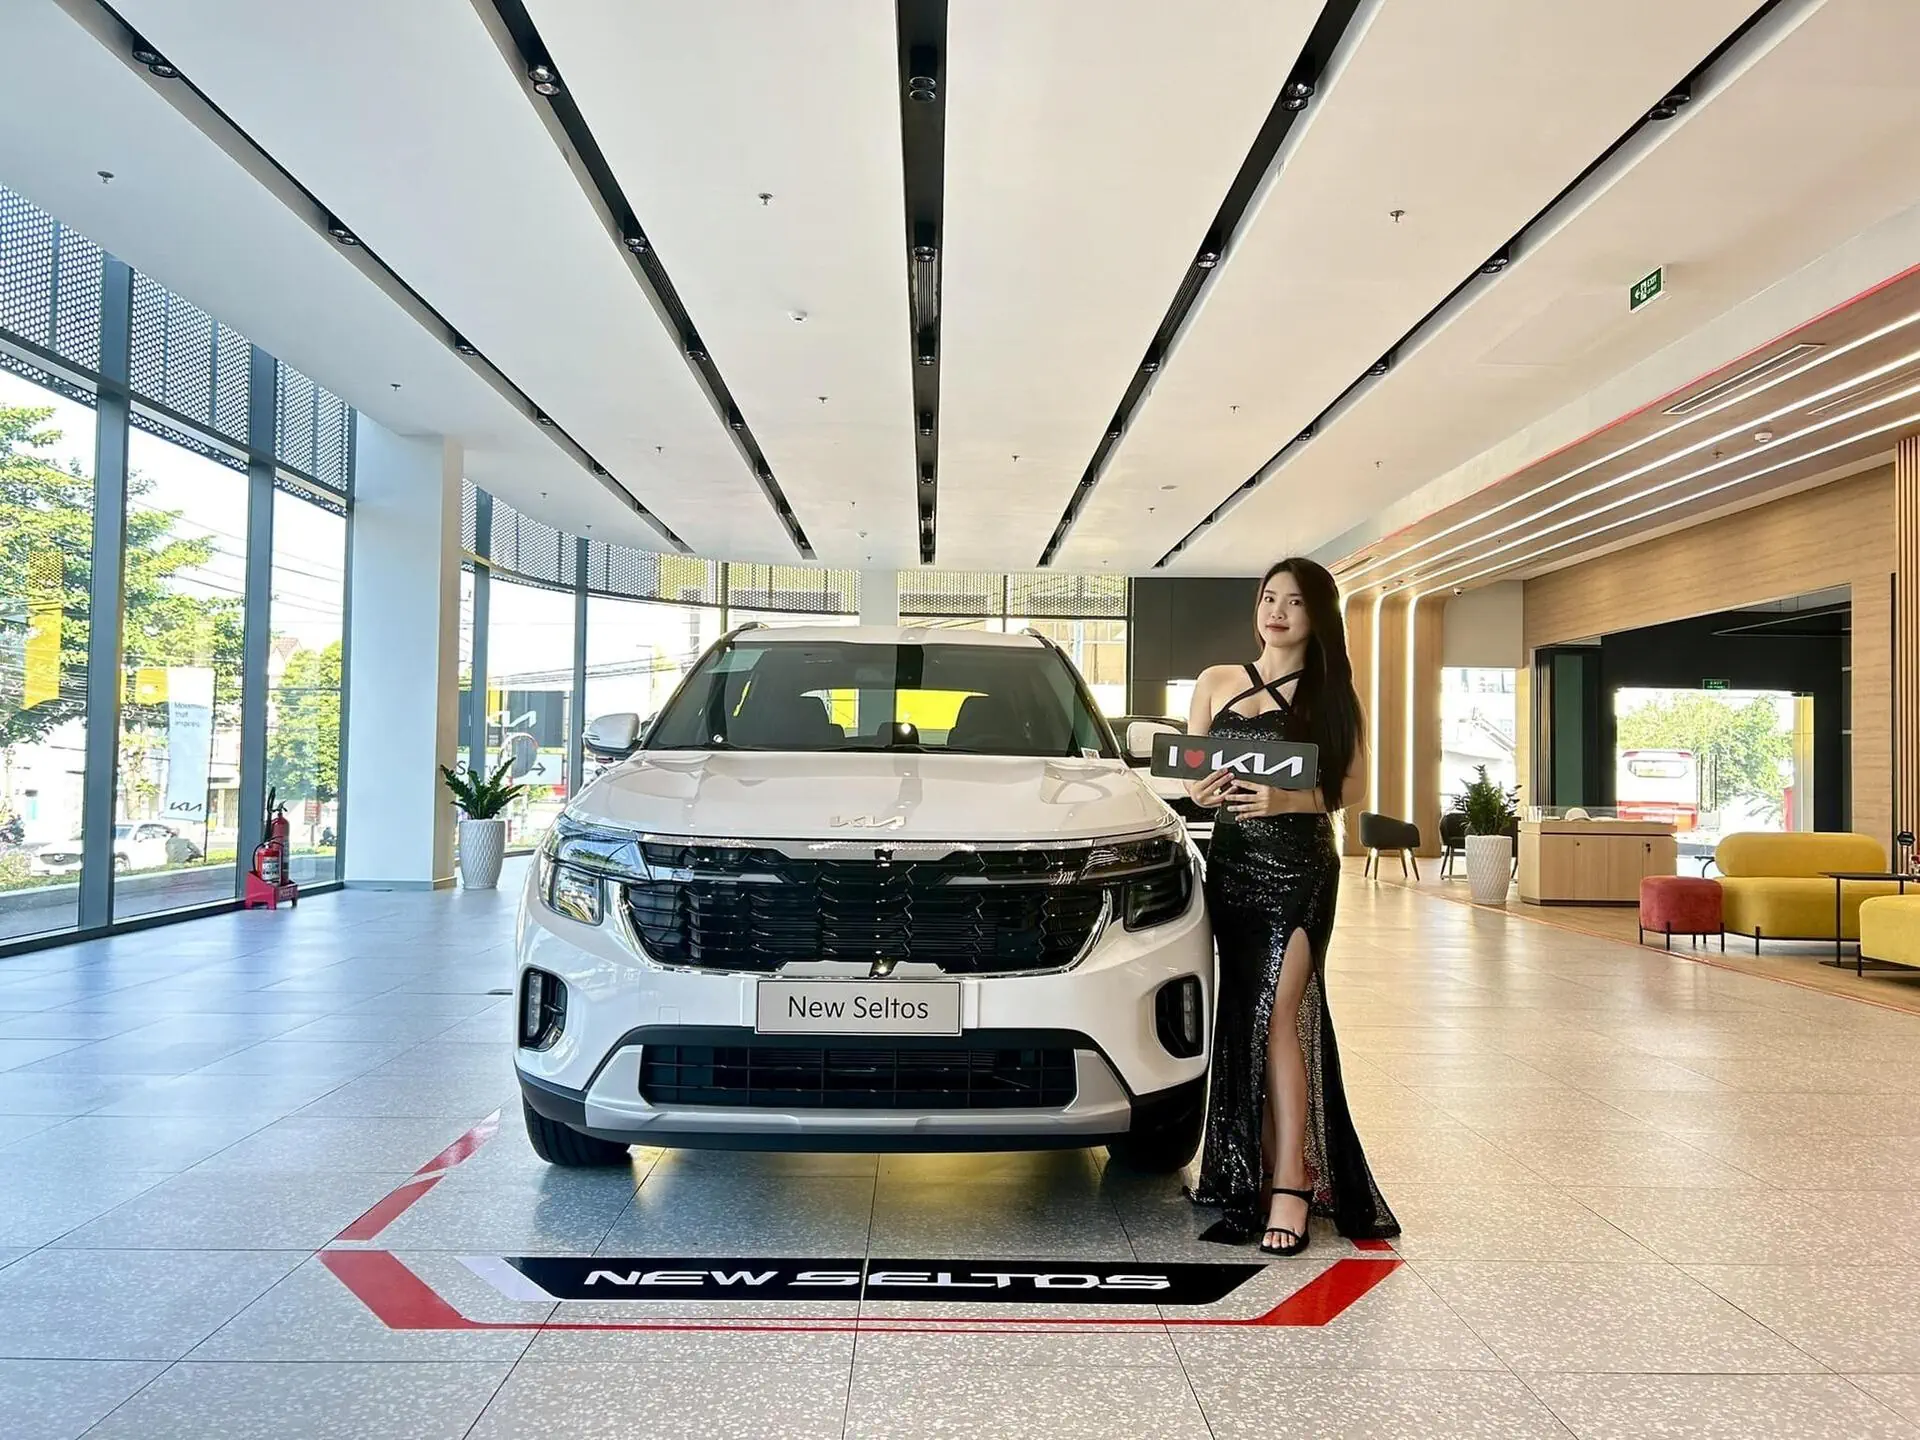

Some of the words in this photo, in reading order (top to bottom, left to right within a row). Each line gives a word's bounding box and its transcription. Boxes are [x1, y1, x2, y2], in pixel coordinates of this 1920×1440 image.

[1168, 745, 1178, 767] I
[1211, 750, 1304, 777] KIA
[169, 801, 202, 812] KIA
[830, 815, 907, 829] KIA
[788, 996, 845, 1018] New
[853, 996, 929, 1019] Seltos
[584, 1270, 779, 1286] NEW
[787, 1271, 1171, 1289] SELTOS
